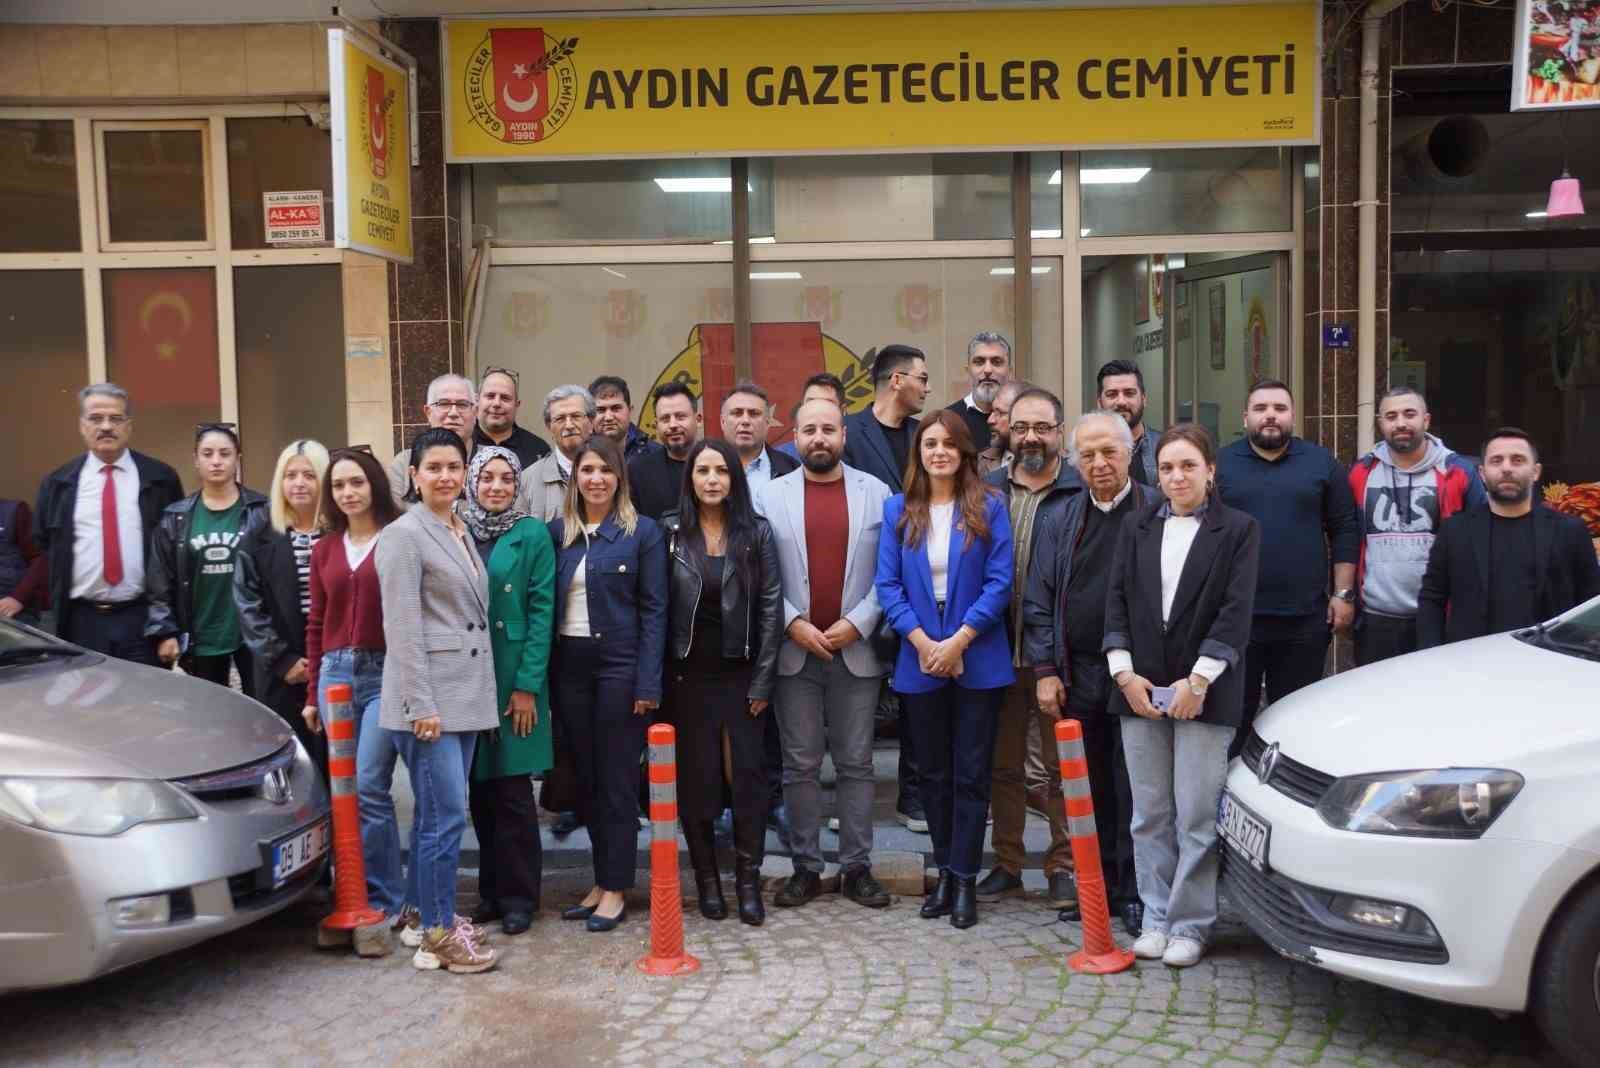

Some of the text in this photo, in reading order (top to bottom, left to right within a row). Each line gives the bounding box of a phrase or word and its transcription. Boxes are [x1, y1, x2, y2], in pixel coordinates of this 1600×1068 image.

[584, 43, 1296, 110] AYDIN GAZETECİLER CEMİYETİ
[510, 122, 539, 131] AYDIN
